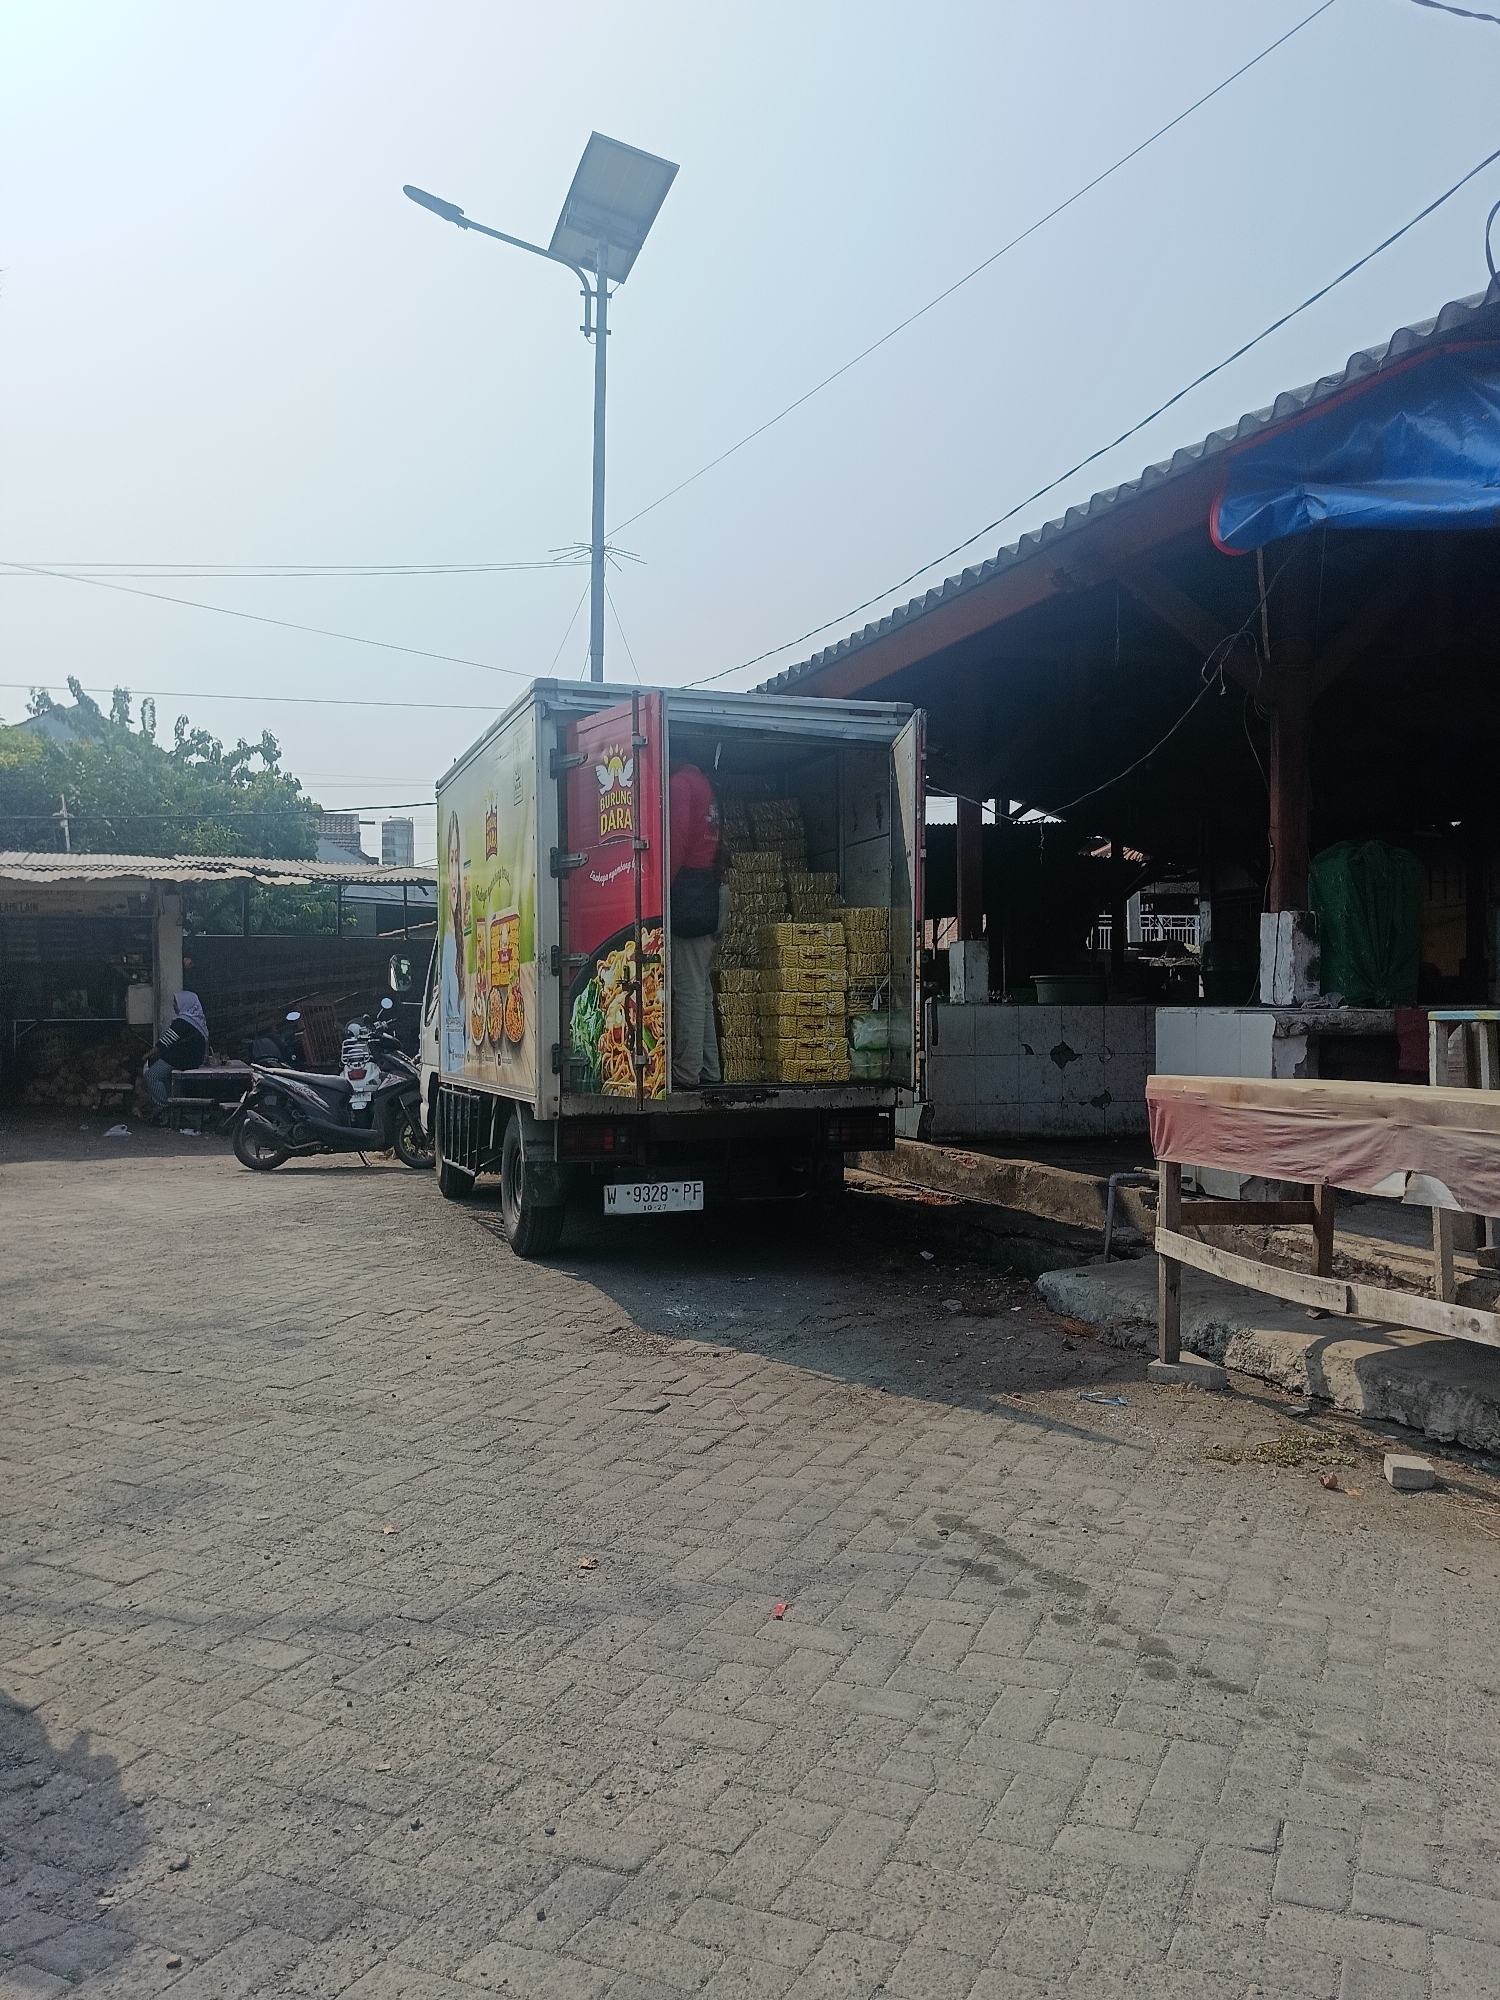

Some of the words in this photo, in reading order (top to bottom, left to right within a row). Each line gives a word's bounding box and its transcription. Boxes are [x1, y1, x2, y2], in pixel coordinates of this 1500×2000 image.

[600, 790, 632, 812] BURUNG
[600, 808, 633, 837] DARA
[606, 1187, 617, 1205] W
[633, 1185, 668, 1203] 9328
[683, 1183, 702, 1201] PF
